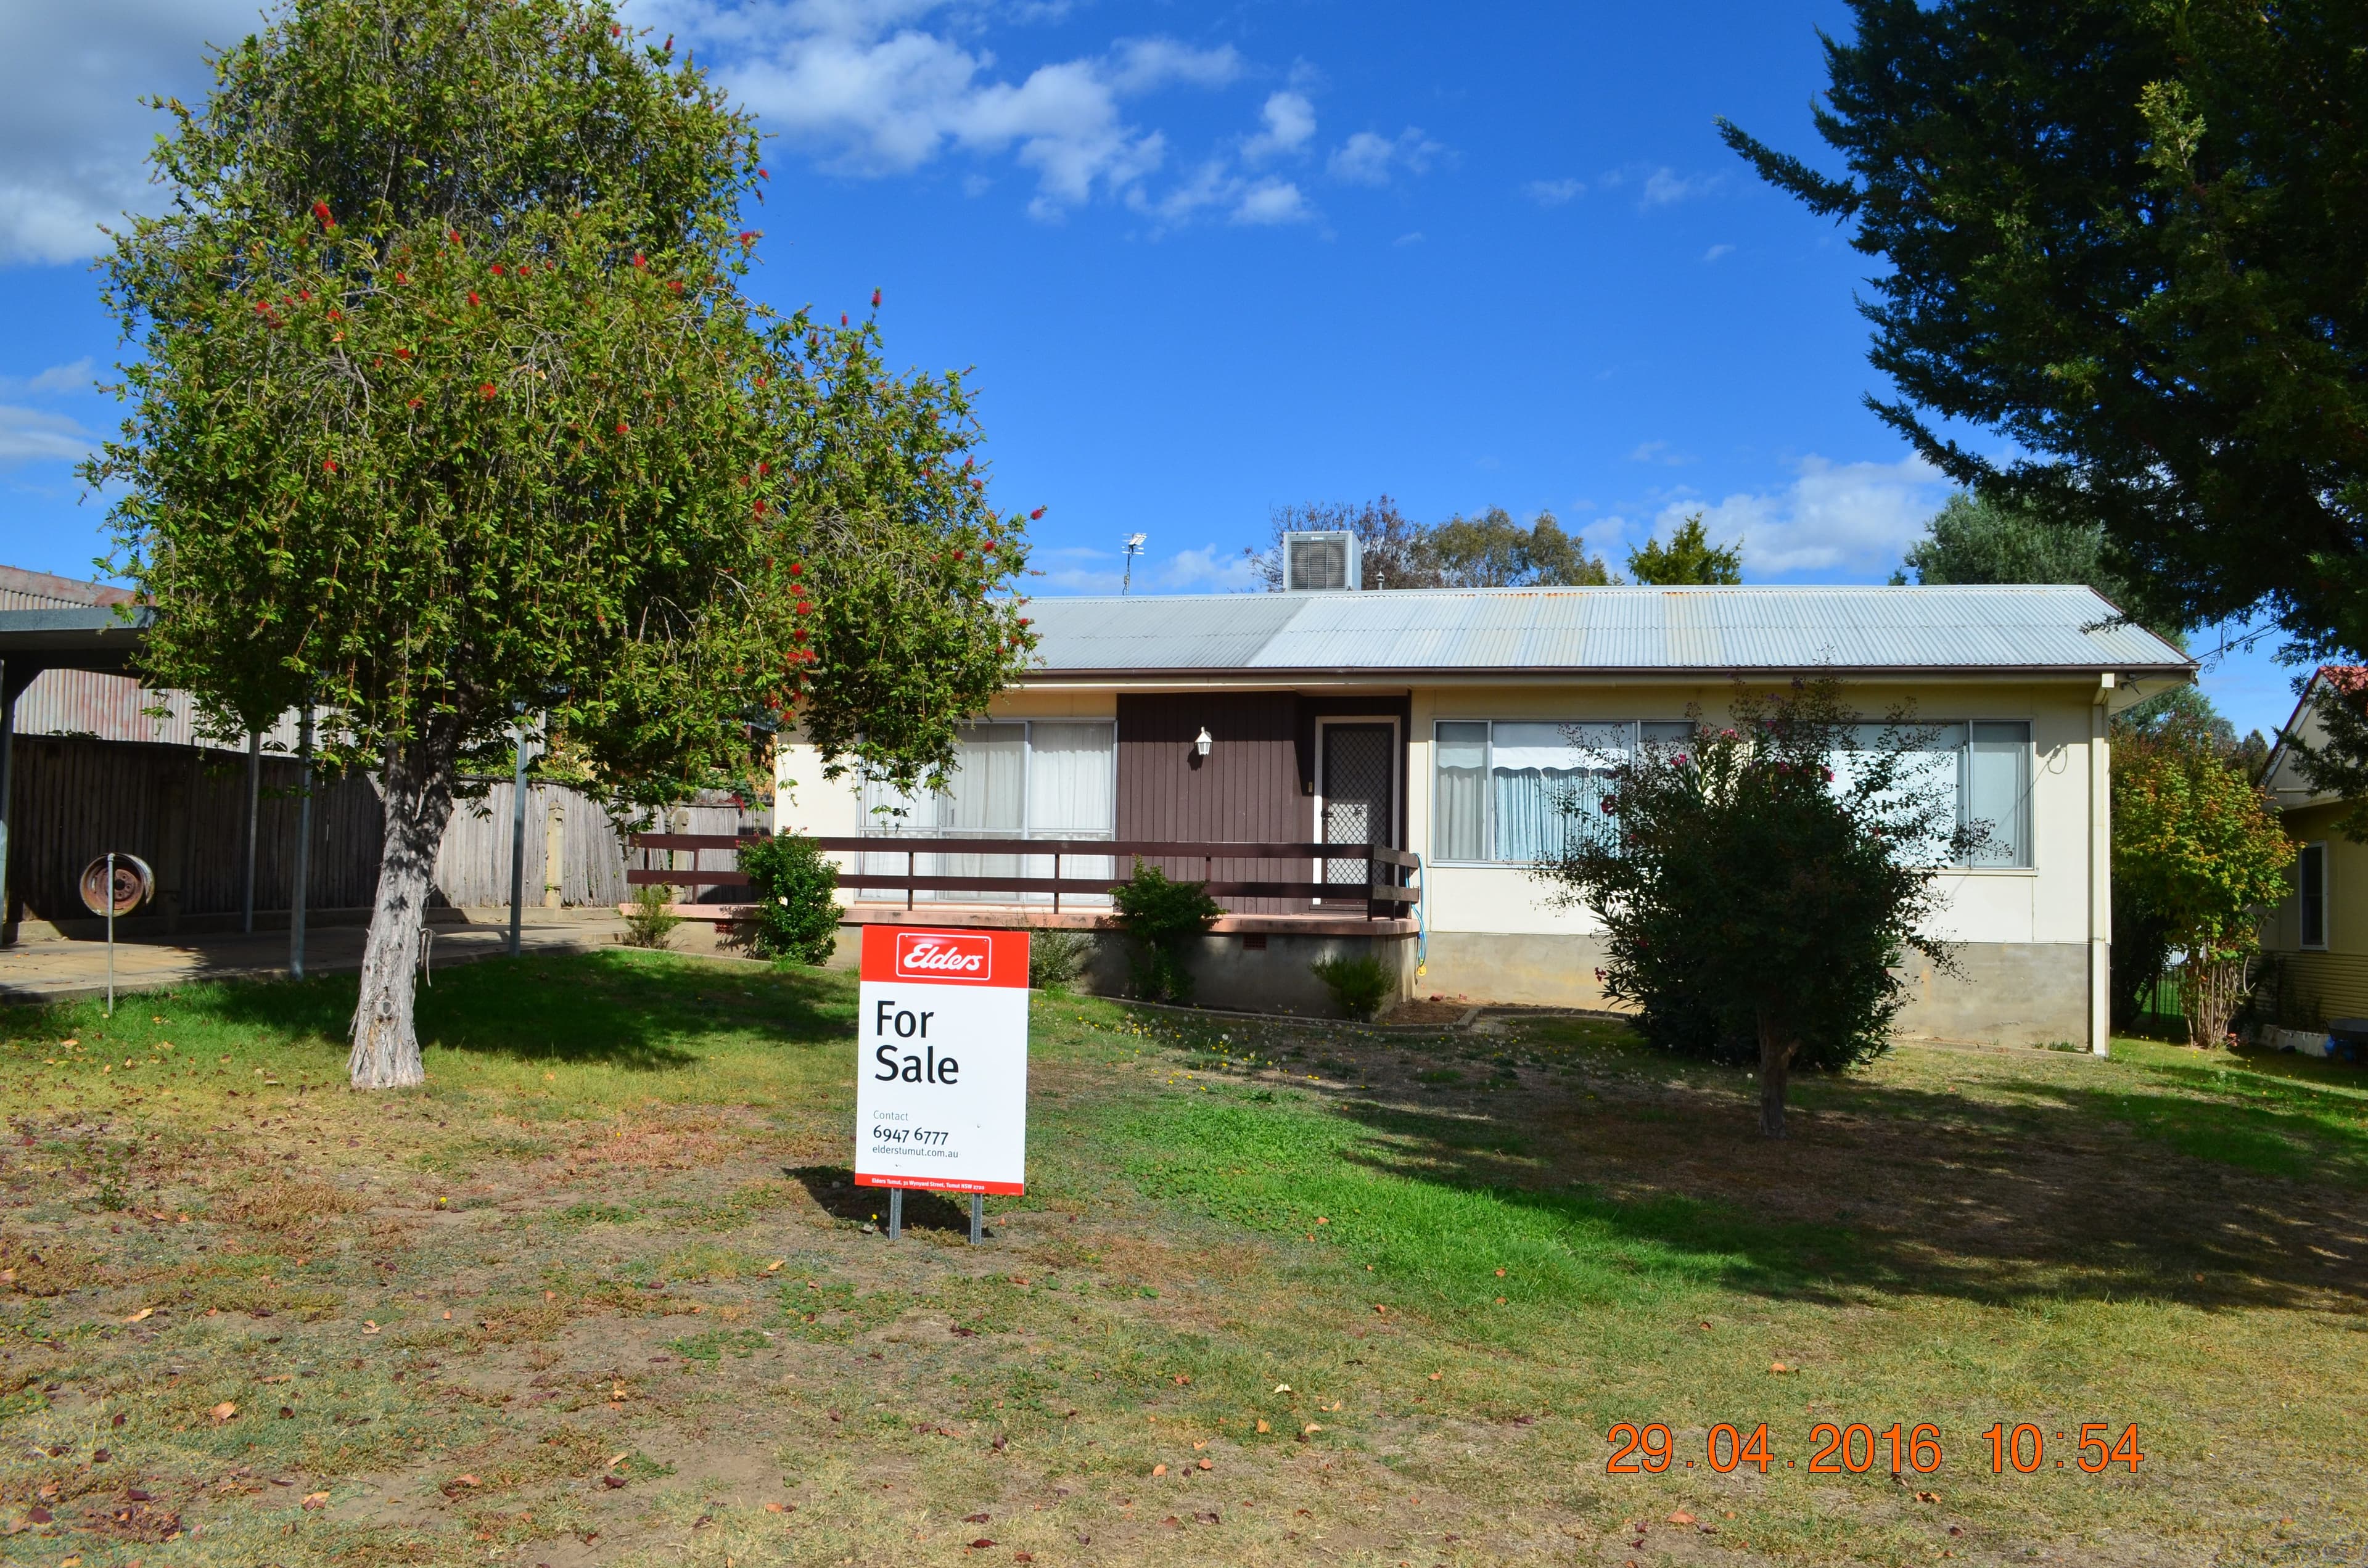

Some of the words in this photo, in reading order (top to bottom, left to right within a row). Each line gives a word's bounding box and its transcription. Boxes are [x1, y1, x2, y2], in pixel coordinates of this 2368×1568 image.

[903, 943, 984, 971] Elders
[876, 1000, 934, 1038] For
[875, 1045, 959, 1085] Sale
[873, 1110, 908, 1121] Contact
[873, 1125, 910, 1143] 6947
[915, 1127, 949, 1146] 6777
[873, 1144, 958, 1158] elderstumut.com.au
